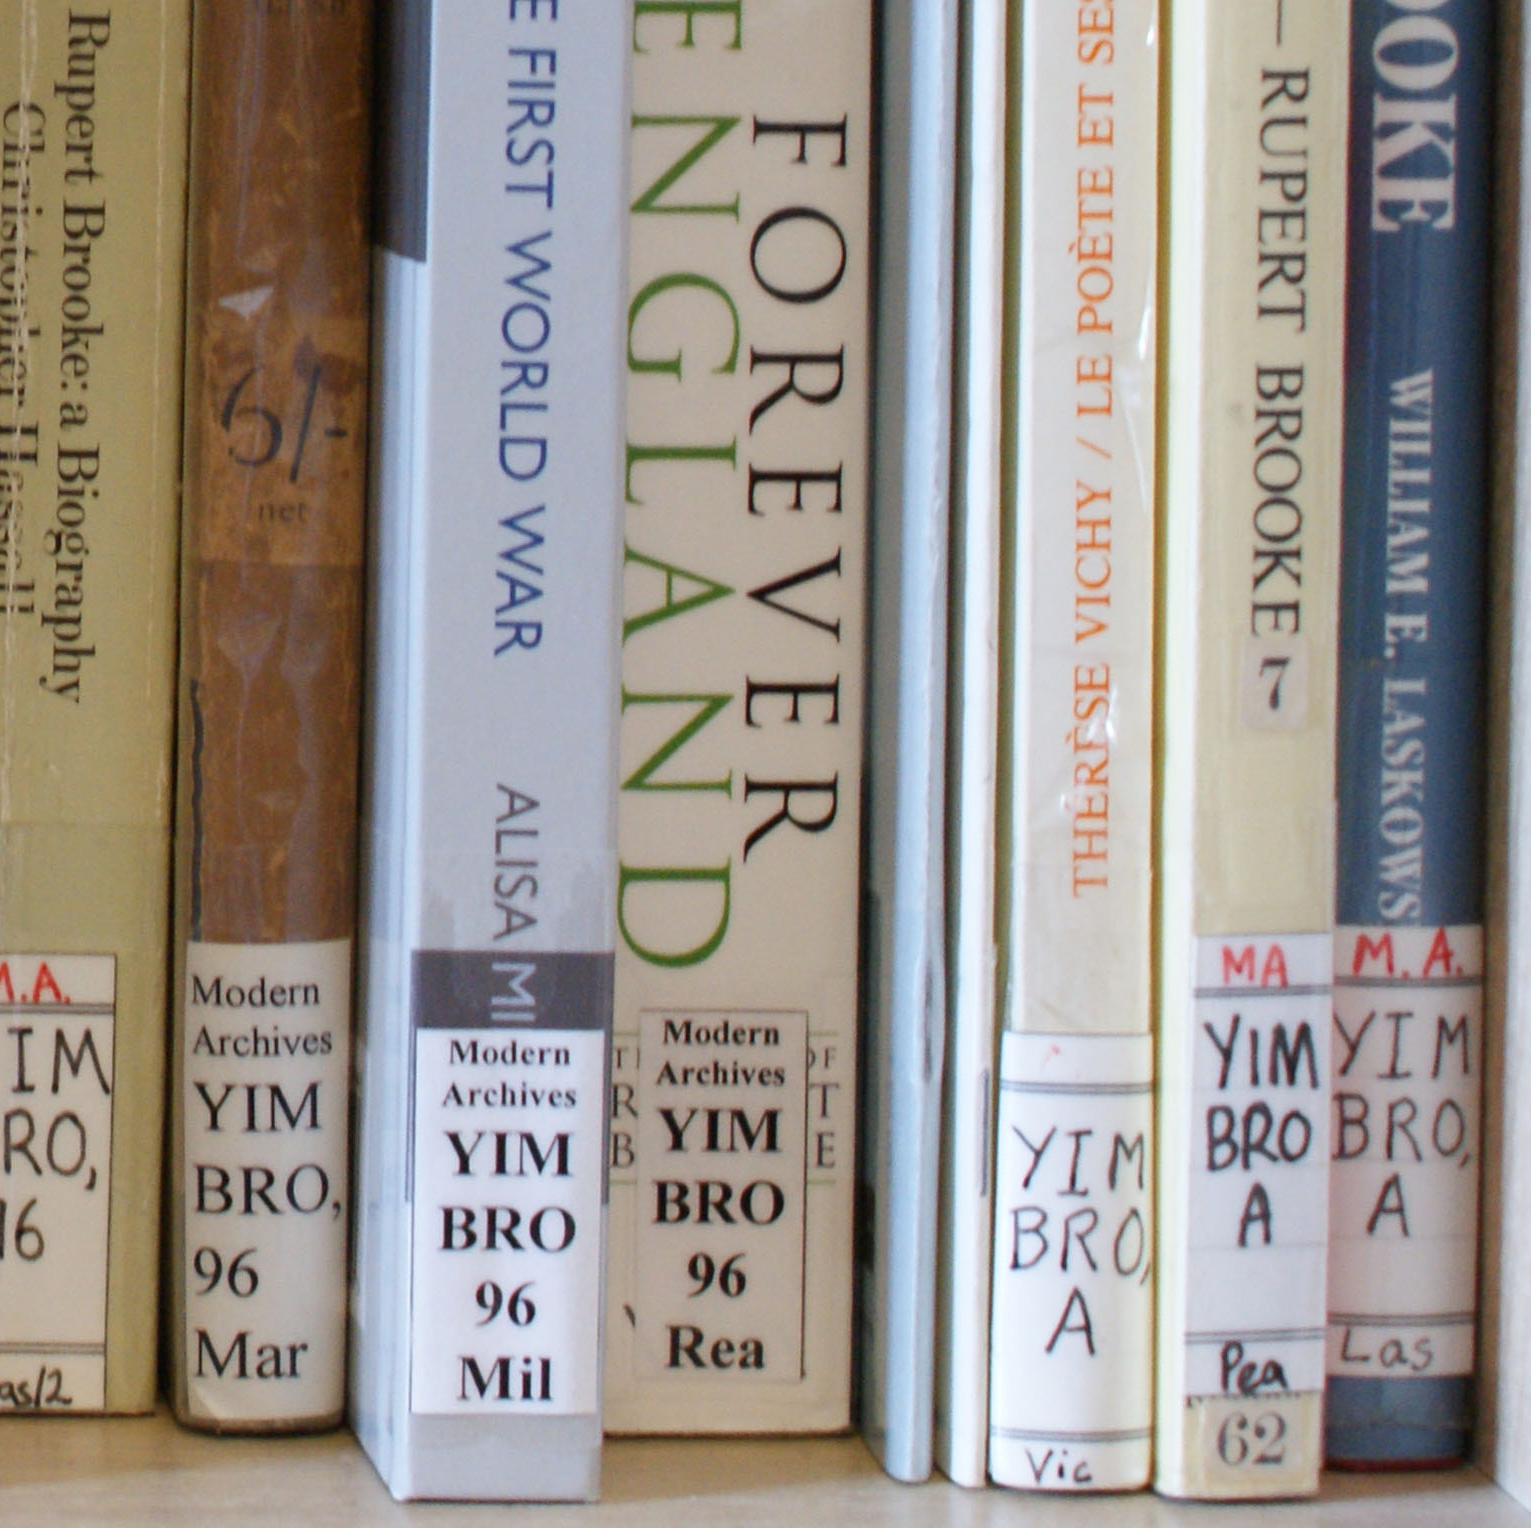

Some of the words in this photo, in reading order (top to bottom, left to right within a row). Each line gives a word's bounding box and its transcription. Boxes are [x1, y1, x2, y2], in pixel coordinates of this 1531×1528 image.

[53, 7, 112, 186] Rupert
[1076, 82, 1116, 150] ET
[504, 46, 557, 211] FIRST
[1255, 66, 1311, 334] RUPERT
[1065, 165, 1116, 338] POÈTE
[57, 199, 107, 392] Brooke:
[497, 228, 554, 483] WORLD
[1076, 354, 1115, 422] LE
[57, 406, 91, 431] a
[742, 112, 849, 865] FOREVER
[1249, 361, 1306, 640] BROOKE
[1382, 367, 1435, 598] WILLIAM
[38, 441, 102, 705] Biography
[492, 503, 548, 658] WAR
[1074, 479, 1114, 646] VICHY
[1381, 611, 1431, 661] E.
[491, 782, 541, 942] ALISA
[189, 974, 322, 1009] Modern
[190, 1023, 334, 1059] Archives
[448, 1038, 572, 1067] Modern
[661, 1018, 782, 1048] Modern
[441, 1081, 579, 1110] Archives
[654, 1059, 787, 1089] Archives
[192, 1079, 324, 1134] YIM
[655, 1107, 783, 1155] YIM
[442, 1129, 575, 1178] YIM
[193, 1162, 343, 1221] BRO,
[651, 1178, 786, 1228] BRO
[438, 1203, 578, 1254] BRO
[192, 1245, 260, 1299] 96
[685, 1250, 748, 1299] 96
[473, 1278, 538, 1329] 96
[193, 1327, 310, 1381] Mar
[665, 1323, 767, 1372] Rea
[455, 1354, 553, 1404] Mil
[1216, 1409, 1289, 1468] 62
